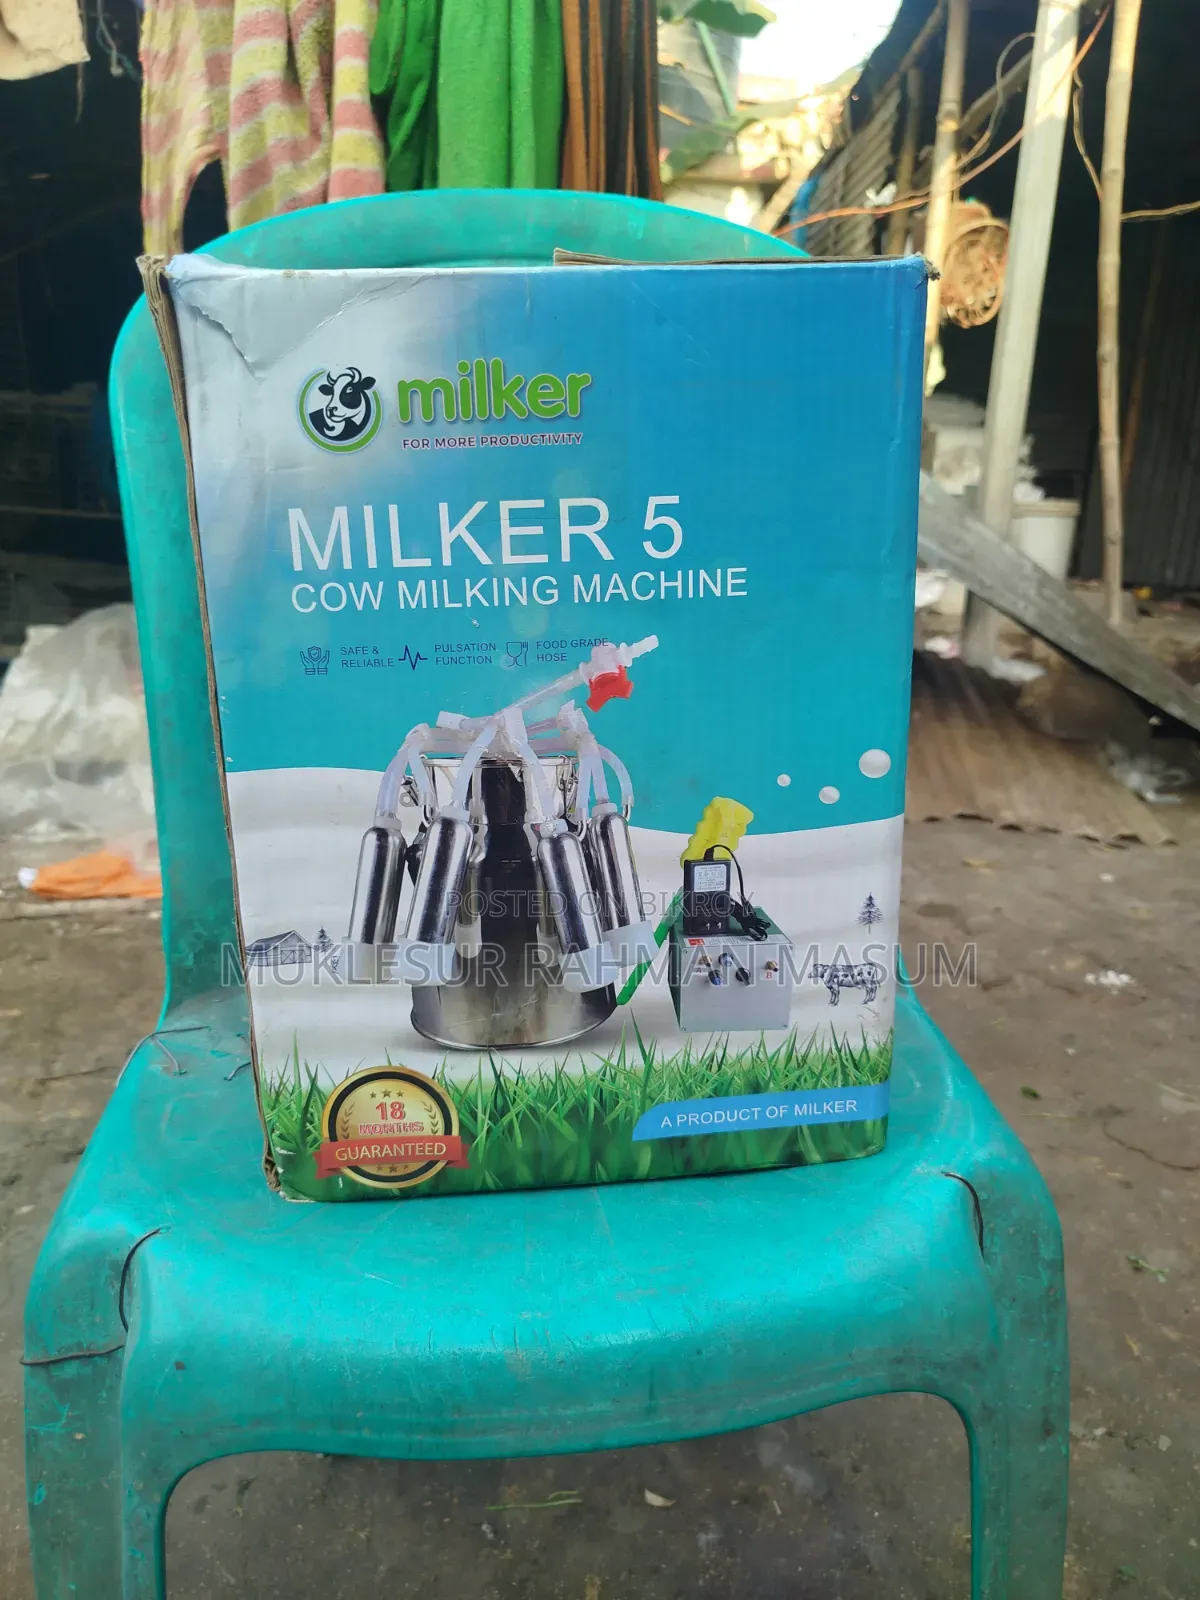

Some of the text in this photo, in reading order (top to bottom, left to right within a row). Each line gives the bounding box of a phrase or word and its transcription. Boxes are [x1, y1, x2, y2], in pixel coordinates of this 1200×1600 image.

[397, 357, 592, 423] milker
[402, 432, 583, 450] FOR MORE PRODUCTIVITY
[288, 495, 683, 572] MILKER 5
[291, 567, 748, 613] COW MILKING MACHINE
[340, 645, 379, 656] SAFE &
[434, 642, 497, 653] PULSATION
[536, 637, 609, 650] FOOD GRADE
[341, 657, 395, 668] RELIABLE
[435, 655, 493, 666] FUNCTION
[536, 652, 568, 662] HOSE
[375, 1101, 407, 1121] 18
[660, 1099, 858, 1129] A PRODUCT OF MILKER
[358, 1121, 425, 1136] MONTHS
[335, 1142, 447, 1161] GUARANTEED
